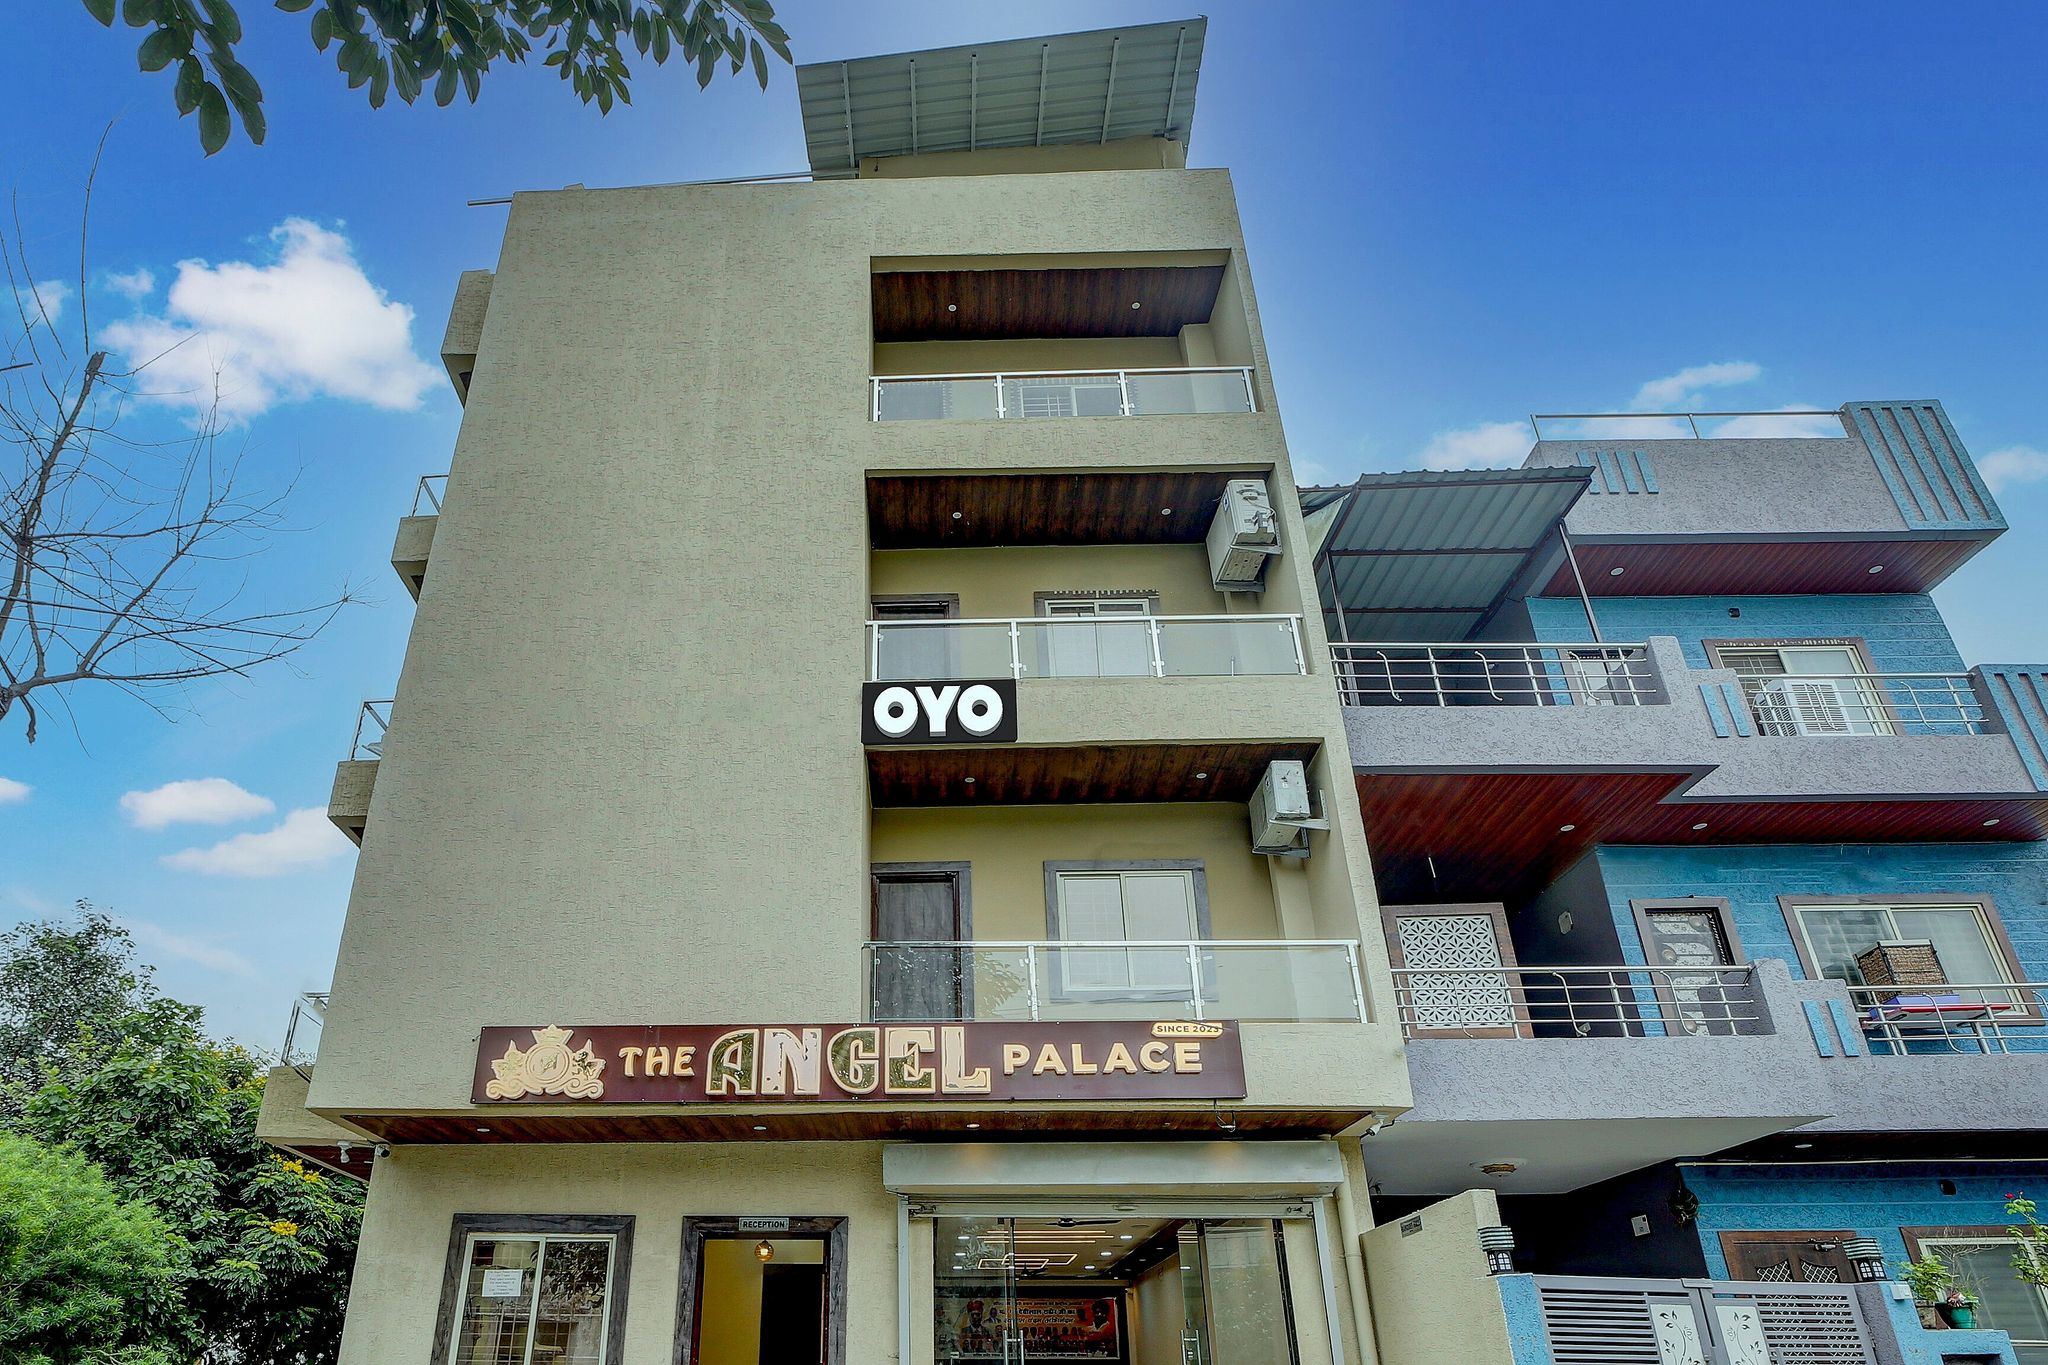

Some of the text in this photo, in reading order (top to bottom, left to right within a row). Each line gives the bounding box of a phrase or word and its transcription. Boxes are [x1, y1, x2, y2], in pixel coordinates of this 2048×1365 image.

[873, 684, 1004, 738] OYO
[1157, 1025, 1190, 1033] SINCE
[618, 1026, 1204, 1095] THE ANGEL PALACE
[742, 1220, 785, 1229] RECEPTION
